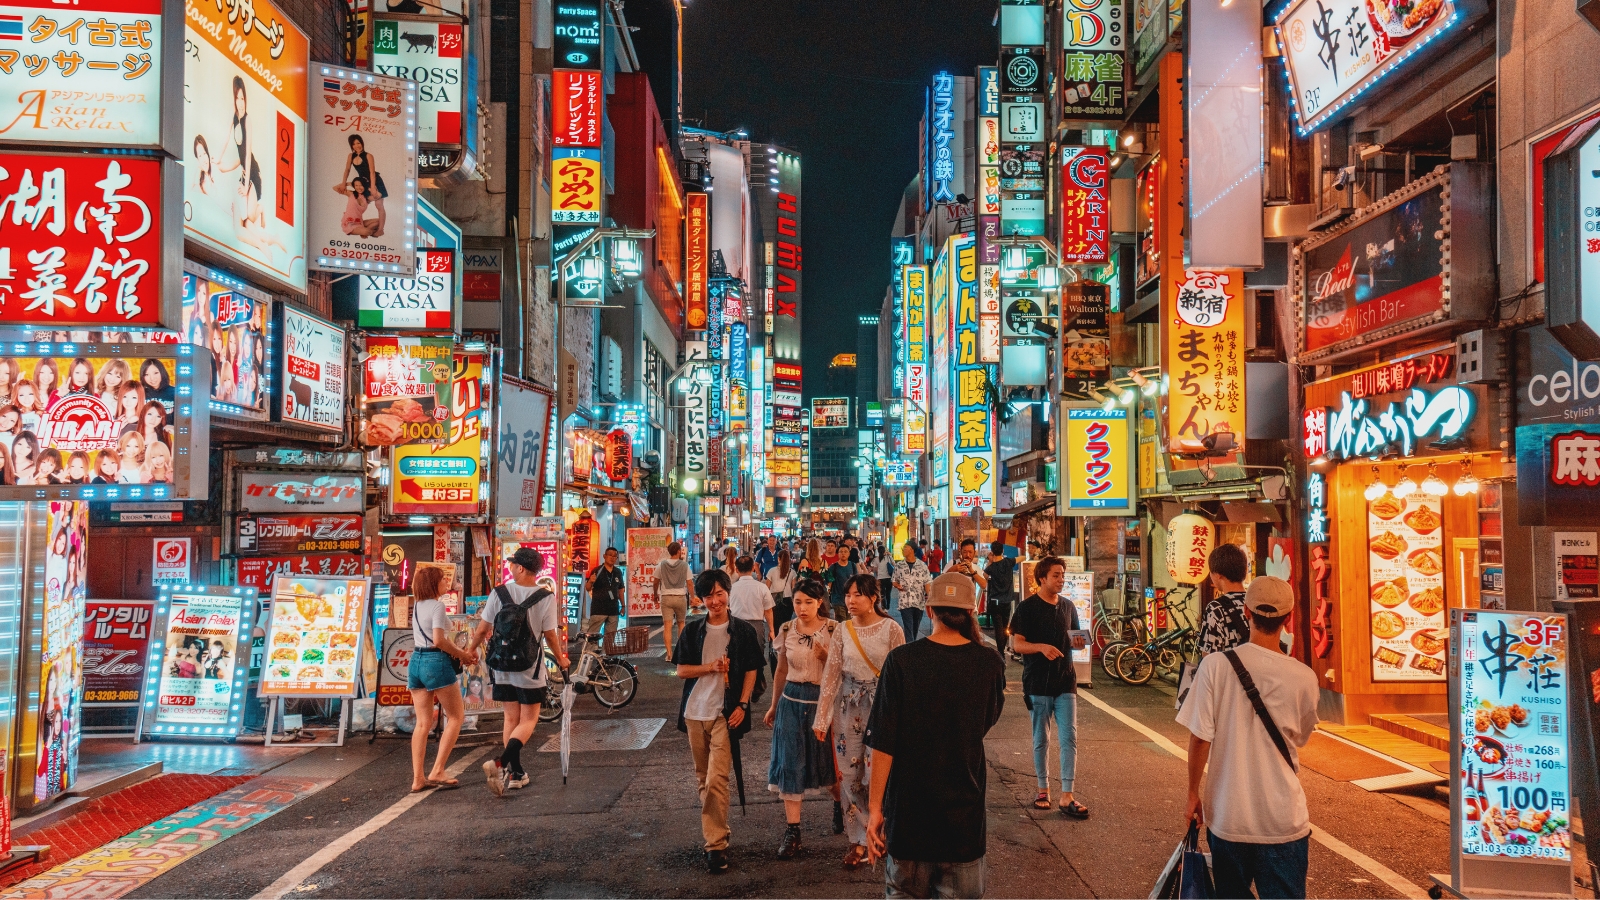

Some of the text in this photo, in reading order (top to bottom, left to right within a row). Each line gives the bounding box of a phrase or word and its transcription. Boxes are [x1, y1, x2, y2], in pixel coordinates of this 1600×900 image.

[559, 7, 597, 17] Party Space
[28, 14, 153, 50] タイ古式
[379, 27, 393, 41] 肉
[1109, 7, 1121, 47] ゴッド
[376, 40, 396, 49] バル
[439, 32, 461, 42] イタリ
[441, 40, 458, 49] アン
[227, 27, 284, 92] Massage
[571, 54, 583, 62] 3F
[1015, 47, 1030, 55] 6F
[0, 49, 153, 81] マッサージ
[1064, 51, 1125, 83] 麻雀
[1344, 52, 1372, 80] KUSHISO
[375, 65, 459, 86] XROSS
[50, 89, 148, 104] アジアンリラックス
[342, 81, 402, 105] タイ古式
[1090, 83, 1123, 106] 4F
[1304, 86, 1322, 114] 3F
[0, 88, 107, 134] Asian
[323, 94, 402, 119] マッサージ
[568, 74, 584, 145] リフレッシュ
[587, 74, 597, 143] レンタルルーム ホステル
[50, 116, 135, 134] Relax
[323, 114, 345, 127] 2F
[933, 70, 955, 201] カラオケの鉄人
[569, 149, 586, 158] 1F
[1064, 149, 1078, 158] 3F
[278, 127, 293, 213] 2F
[1069, 153, 1106, 255] CARINA
[553, 210, 599, 222] 博多天神
[1066, 189, 1075, 253] 個室ダイニング
[1074, 189, 1088, 254] カリーナ
[329, 239, 351, 248] 60分
[554, 227, 595, 252] Party Space
[322, 247, 402, 264] 03-3207-5527
[427, 254, 450, 265] イタリ
[691, 206, 702, 303] 個室ダイニング居酒屋
[430, 263, 447, 271] アン
[364, 274, 445, 292] XROSS
[579, 282, 592, 290] B1
[1312, 256, 1360, 303] Real
[374, 292, 437, 310] CASA
[988, 301, 998, 310] 1F
[1068, 303, 1104, 314] Walton's
[1069, 294, 1087, 304] BBQ
[1179, 287, 1225, 316] 新宿
[217, 296, 251, 325] 即デート
[1194, 312, 1211, 325] の
[286, 316, 324, 338] ヘルシー
[286, 332, 314, 359] 肉バル
[732, 324, 745, 369] カラオケ
[731, 369, 744, 378] 747
[1351, 353, 1451, 400] 旭川味噌ラーメン
[1078, 380, 1096, 392] 2F
[1177, 329, 1213, 440] まっちゃん
[1226, 379, 1240, 413] 水炊き
[686, 348, 706, 473] とんかつにいむら
[1069, 408, 1125, 418] オンラインカフェ
[1563, 407, 1596, 420] Stylish
[37, 413, 122, 449] KIRARI
[57, 440, 118, 450] 出会いカフェ
[1084, 422, 1112, 497] クラウン
[421, 488, 472, 501] 受付3F
[955, 495, 991, 507] マンボー
[239, 519, 257, 549] 3F
[259, 524, 312, 538] レンタルルーム
[311, 516, 362, 541] Eden
[305, 540, 361, 551] 03-3203-9666
[1186, 524, 1209, 578] 鉄なべ餃子
[1309, 545, 1329, 659] ラーメン
[171, 608, 237, 626] Asian Relax
[93, 621, 147, 639] ルーム
[170, 625, 230, 636] Welcome Foreigner
[1522, 618, 1562, 647] 3F
[1477, 619, 1562, 701] 串荘
[84, 690, 140, 701] 03-3203-9666
[1520, 696, 1563, 705] KUSHISO
[1534, 744, 1561, 756] 268円
